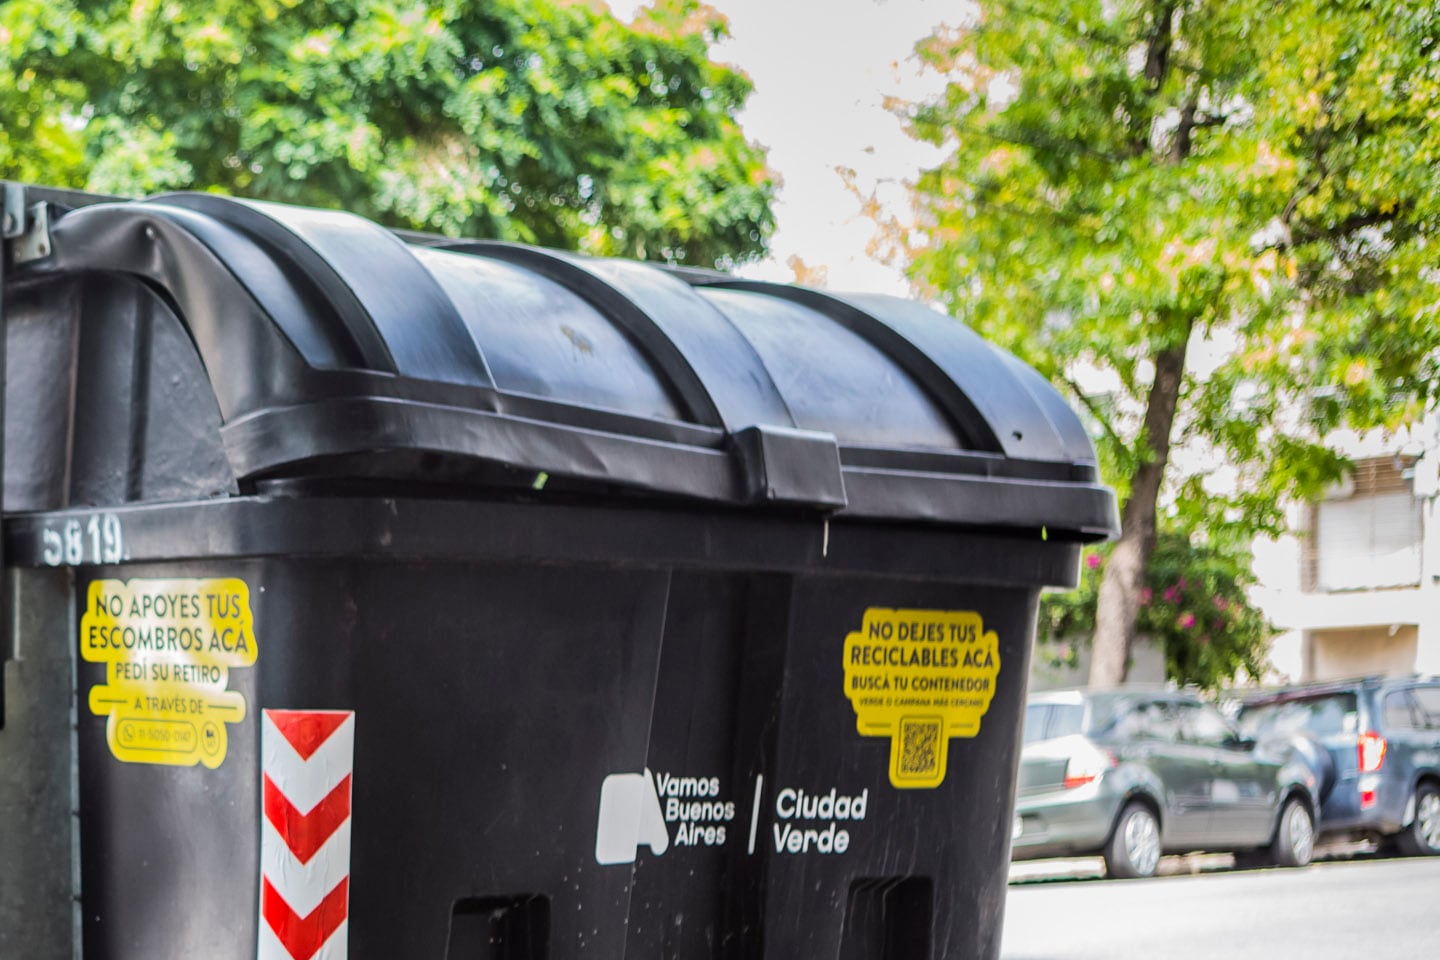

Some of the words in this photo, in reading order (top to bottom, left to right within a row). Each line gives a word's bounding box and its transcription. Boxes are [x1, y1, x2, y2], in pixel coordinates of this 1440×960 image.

[43, 513, 122, 567] 5819
[95, 595, 123, 617] NO
[129, 595, 200, 618] APOYES
[206, 594, 241, 618] TUS
[89, 626, 203, 651] ESCOMBROS
[208, 621, 248, 653] ACÁ
[869, 621, 893, 641] NO
[898, 622, 944, 642] DEJES
[949, 623, 976, 644] TUS
[851, 646, 958, 668] RECICLABLES
[962, 645, 994, 669] ACÁ
[116, 659, 148, 680] PEDÍ
[152, 663, 169, 681] SU
[174, 665, 221, 683] RETIRO
[852, 672, 890, 690] BUSCÁ
[894, 676, 908, 691] TU
[911, 677, 990, 692] CONTENEDOR
[134, 698, 143, 710] A
[146, 695, 187, 713] TRAVÉS
[190, 700, 204, 714] DE
[656, 772, 720, 797] Vamos
[665, 798, 735, 822] Buenos
[775, 787, 869, 820] Ciudad
[673, 822, 727, 847] Aires
[773, 822, 850, 854] Verde
